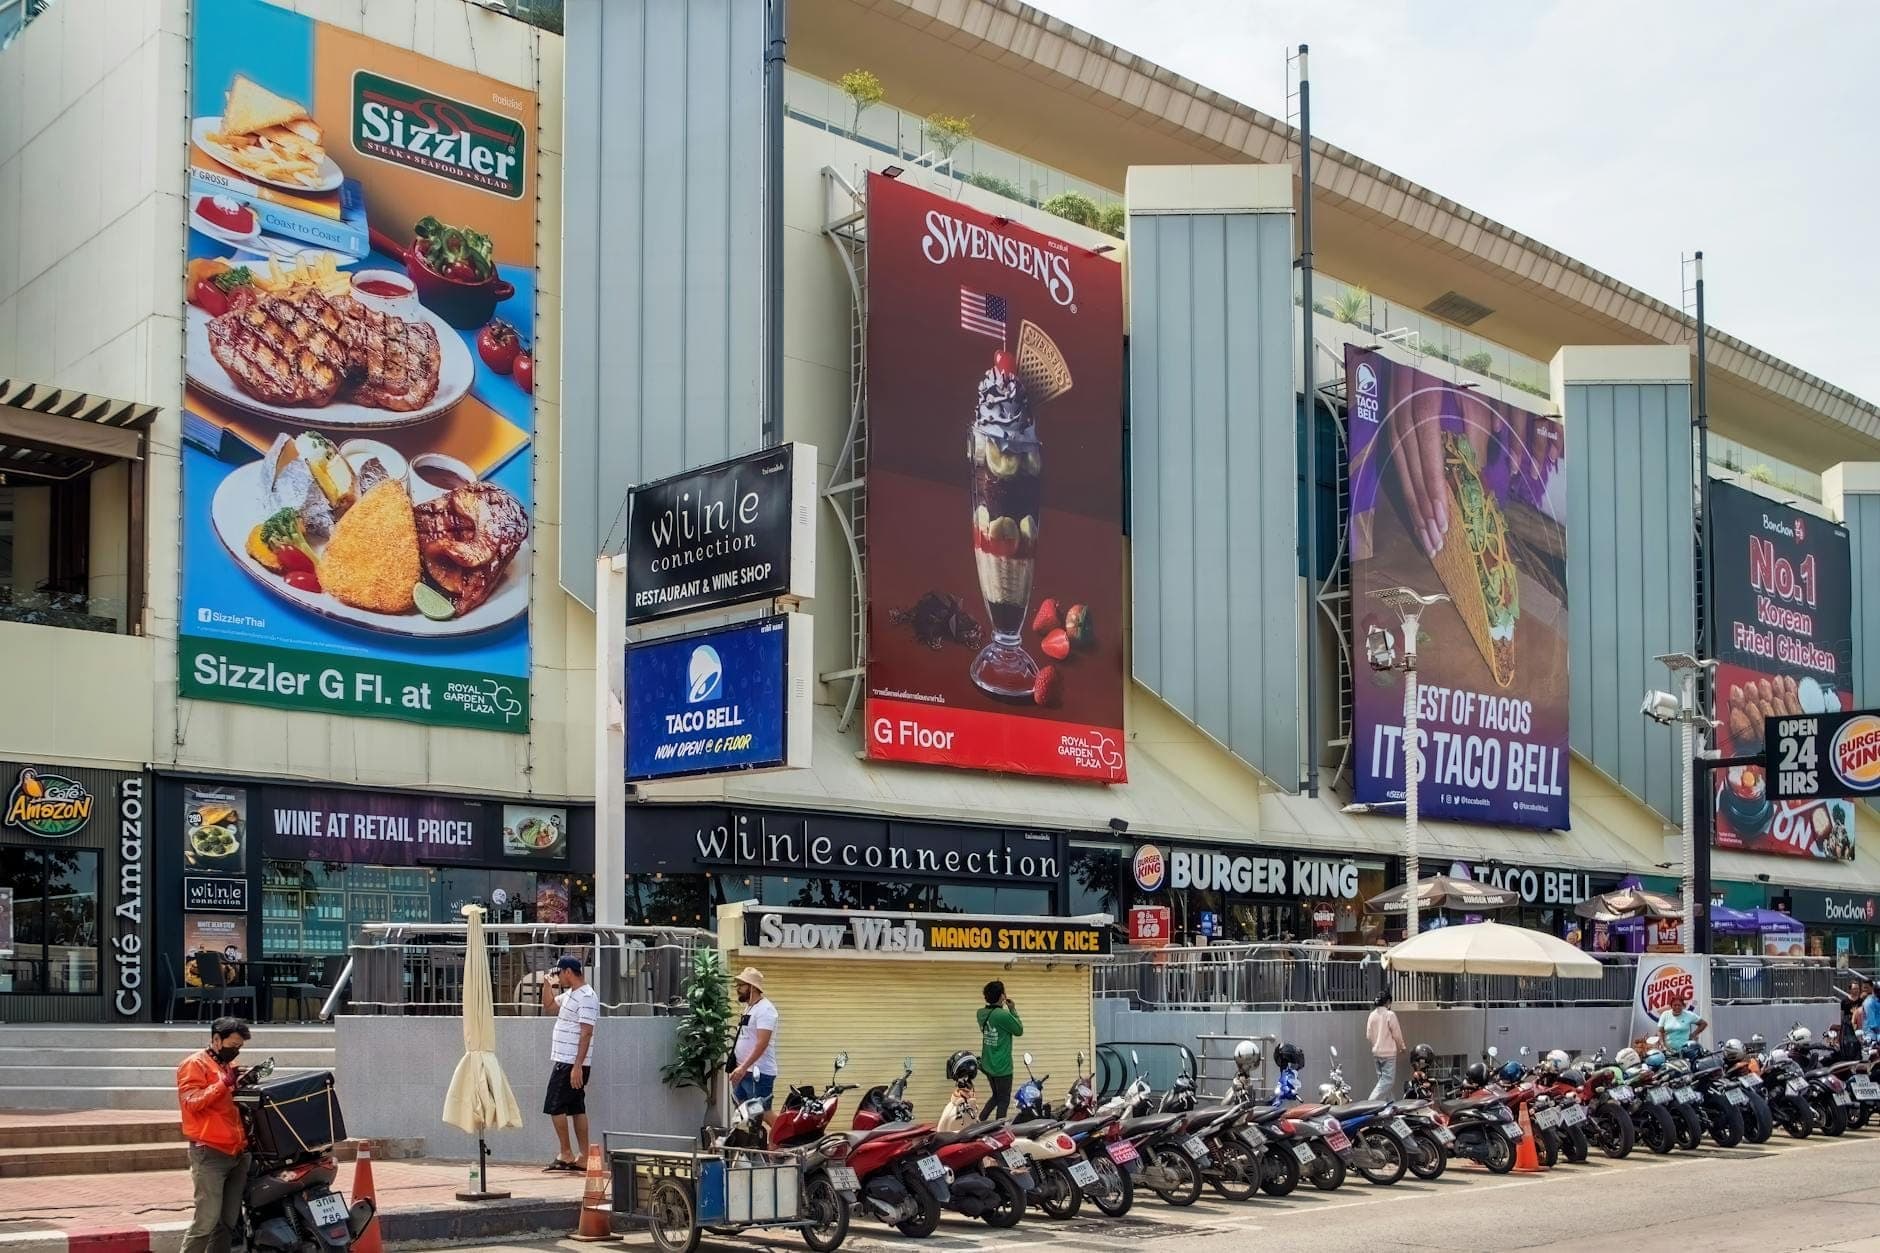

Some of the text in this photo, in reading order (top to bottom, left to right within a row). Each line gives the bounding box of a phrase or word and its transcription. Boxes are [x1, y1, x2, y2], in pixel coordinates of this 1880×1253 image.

[362, 102, 515, 180] Sizzler
[200, 171, 229, 187] GROSSI
[367, 142, 508, 190] STEAK SEAFOOD SALAD
[266, 214, 342, 243] Coast to Coast
[922, 210, 1074, 306] SWENSEN'S
[1356, 394, 1379, 412] TACO
[1357, 408, 1379, 424] BELL
[1762, 513, 1794, 538] Bonchon
[651, 532, 757, 573] connection
[635, 562, 772, 607] RESTAURANT & WINE SHOP
[1750, 535, 1817, 607] No.1
[212, 611, 265, 628] SizzlerThai
[1757, 595, 1812, 636] Korean
[1733, 621, 1836, 674] Fried Chicken
[194, 654, 431, 710] Sizzler G Fl. at
[448, 683, 481, 695] ROYAL
[443, 692, 485, 704] GARDEN
[464, 703, 494, 714] PLAZA
[1404, 685, 1532, 735] EST OF TACOS
[665, 705, 743, 735] TACO BELL
[873, 718, 955, 750] G Floor
[1779, 718, 1818, 737] OPEN
[655, 743, 677, 760] NOW
[677, 738, 704, 757] OPEN!
[723, 734, 752, 752] FLOOR
[1058, 746, 1093, 758] GARDEN
[1061, 735, 1089, 748] ROYAL
[1779, 736, 1818, 771] 24
[1075, 756, 1101, 768] PLAZA
[1433, 731, 1500, 790] TACO
[1506, 741, 1562, 796] BELL
[1841, 744, 1880, 775] KIN
[44, 784, 84, 799] Café
[1779, 770, 1819, 795] HRS
[274, 808, 473, 846] WINE AT RETAIL PRICE!
[842, 846, 1060, 879] connection
[1138, 855, 1160, 867] BURGER
[1138, 863, 1161, 878] KING
[1171, 852, 1359, 898] BURGER KING
[112, 777, 142, 1016] Café Amazon
[1473, 866, 1592, 904] TACO BELL
[191, 898, 241, 906] connection
[1418, 898, 1431, 907] ING
[1825, 896, 1867, 920] Bonchon
[759, 914, 1099, 952] Snow Wish MANGO STICKY RICE
[1138, 924, 1160, 938] 169
[1647, 974, 1693, 995] BURGER
[1648, 985, 1694, 1013] KING
